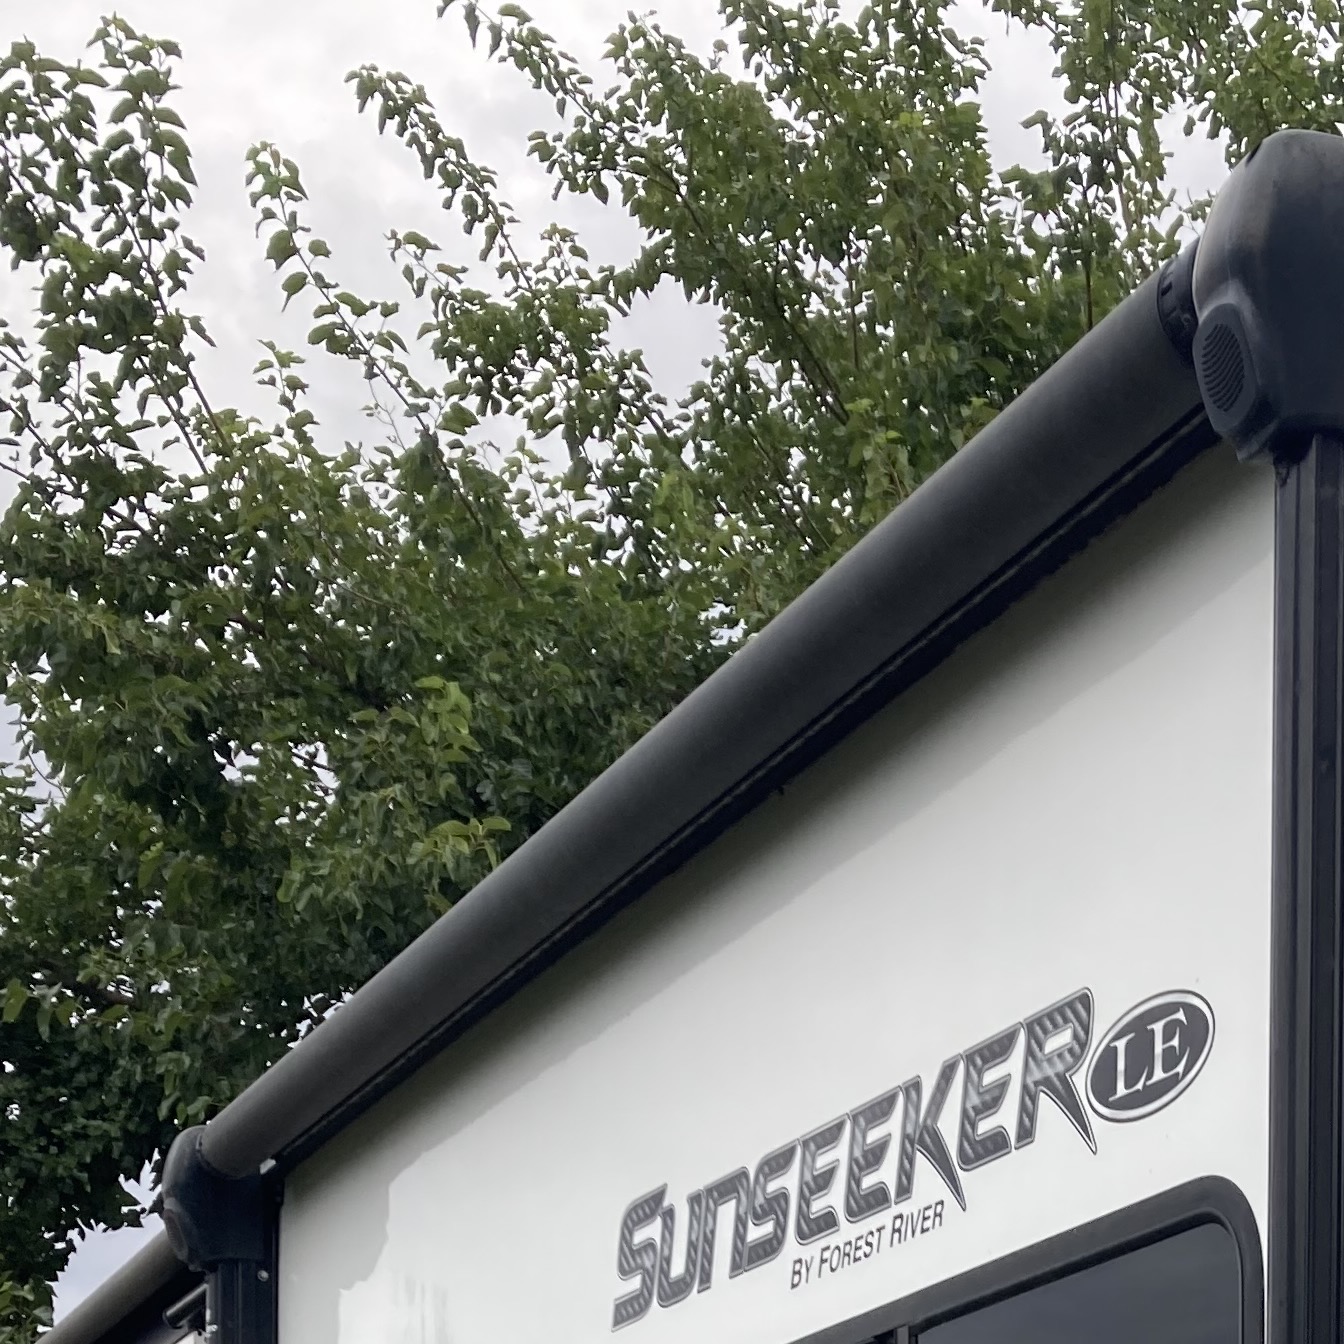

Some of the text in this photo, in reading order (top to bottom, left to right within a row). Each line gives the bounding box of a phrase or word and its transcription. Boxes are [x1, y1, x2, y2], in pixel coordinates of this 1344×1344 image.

[1108, 1006, 1190, 1102] LE
[791, 1199, 945, 1290] BY FOREST RIVER
